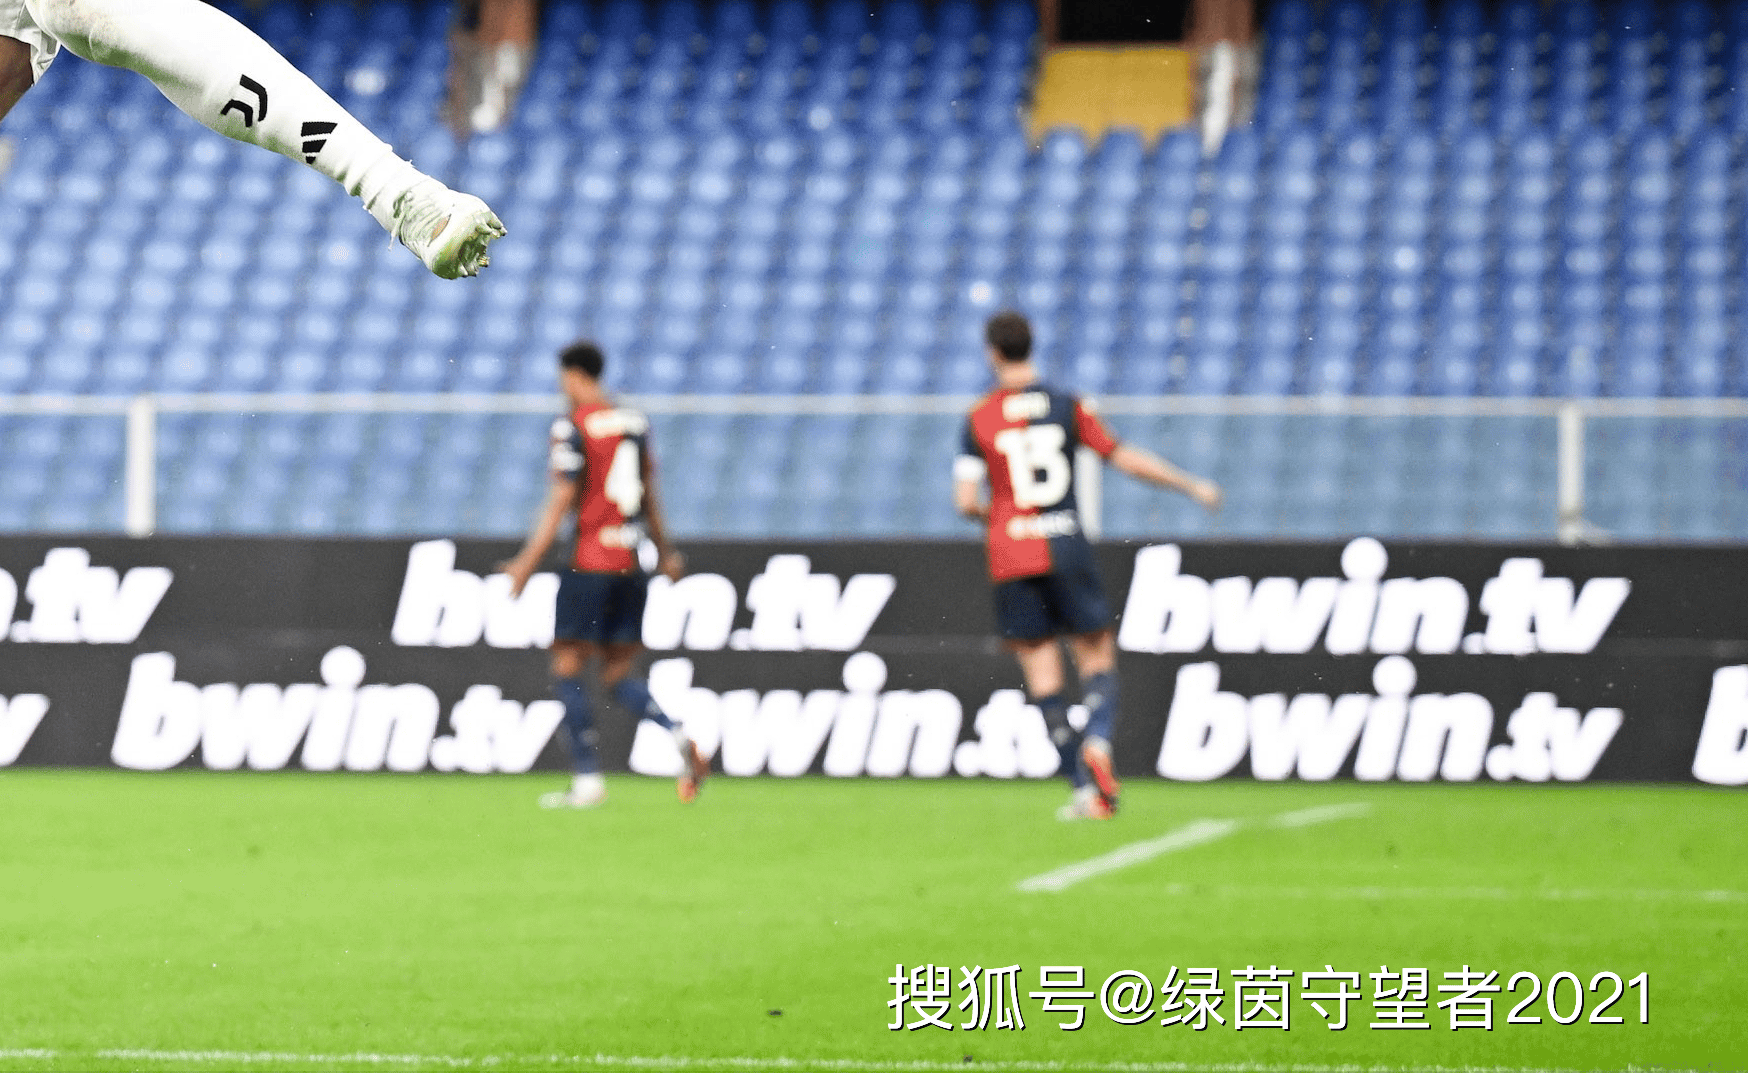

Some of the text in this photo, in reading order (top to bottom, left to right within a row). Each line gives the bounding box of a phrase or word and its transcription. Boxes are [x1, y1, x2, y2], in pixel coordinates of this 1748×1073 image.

[994, 423, 1072, 509] 13
[1118, 536, 1631, 655] bwin.tv
[110, 645, 565, 773] bwin.tv
[1157, 656, 1623, 782] bwin.tv
